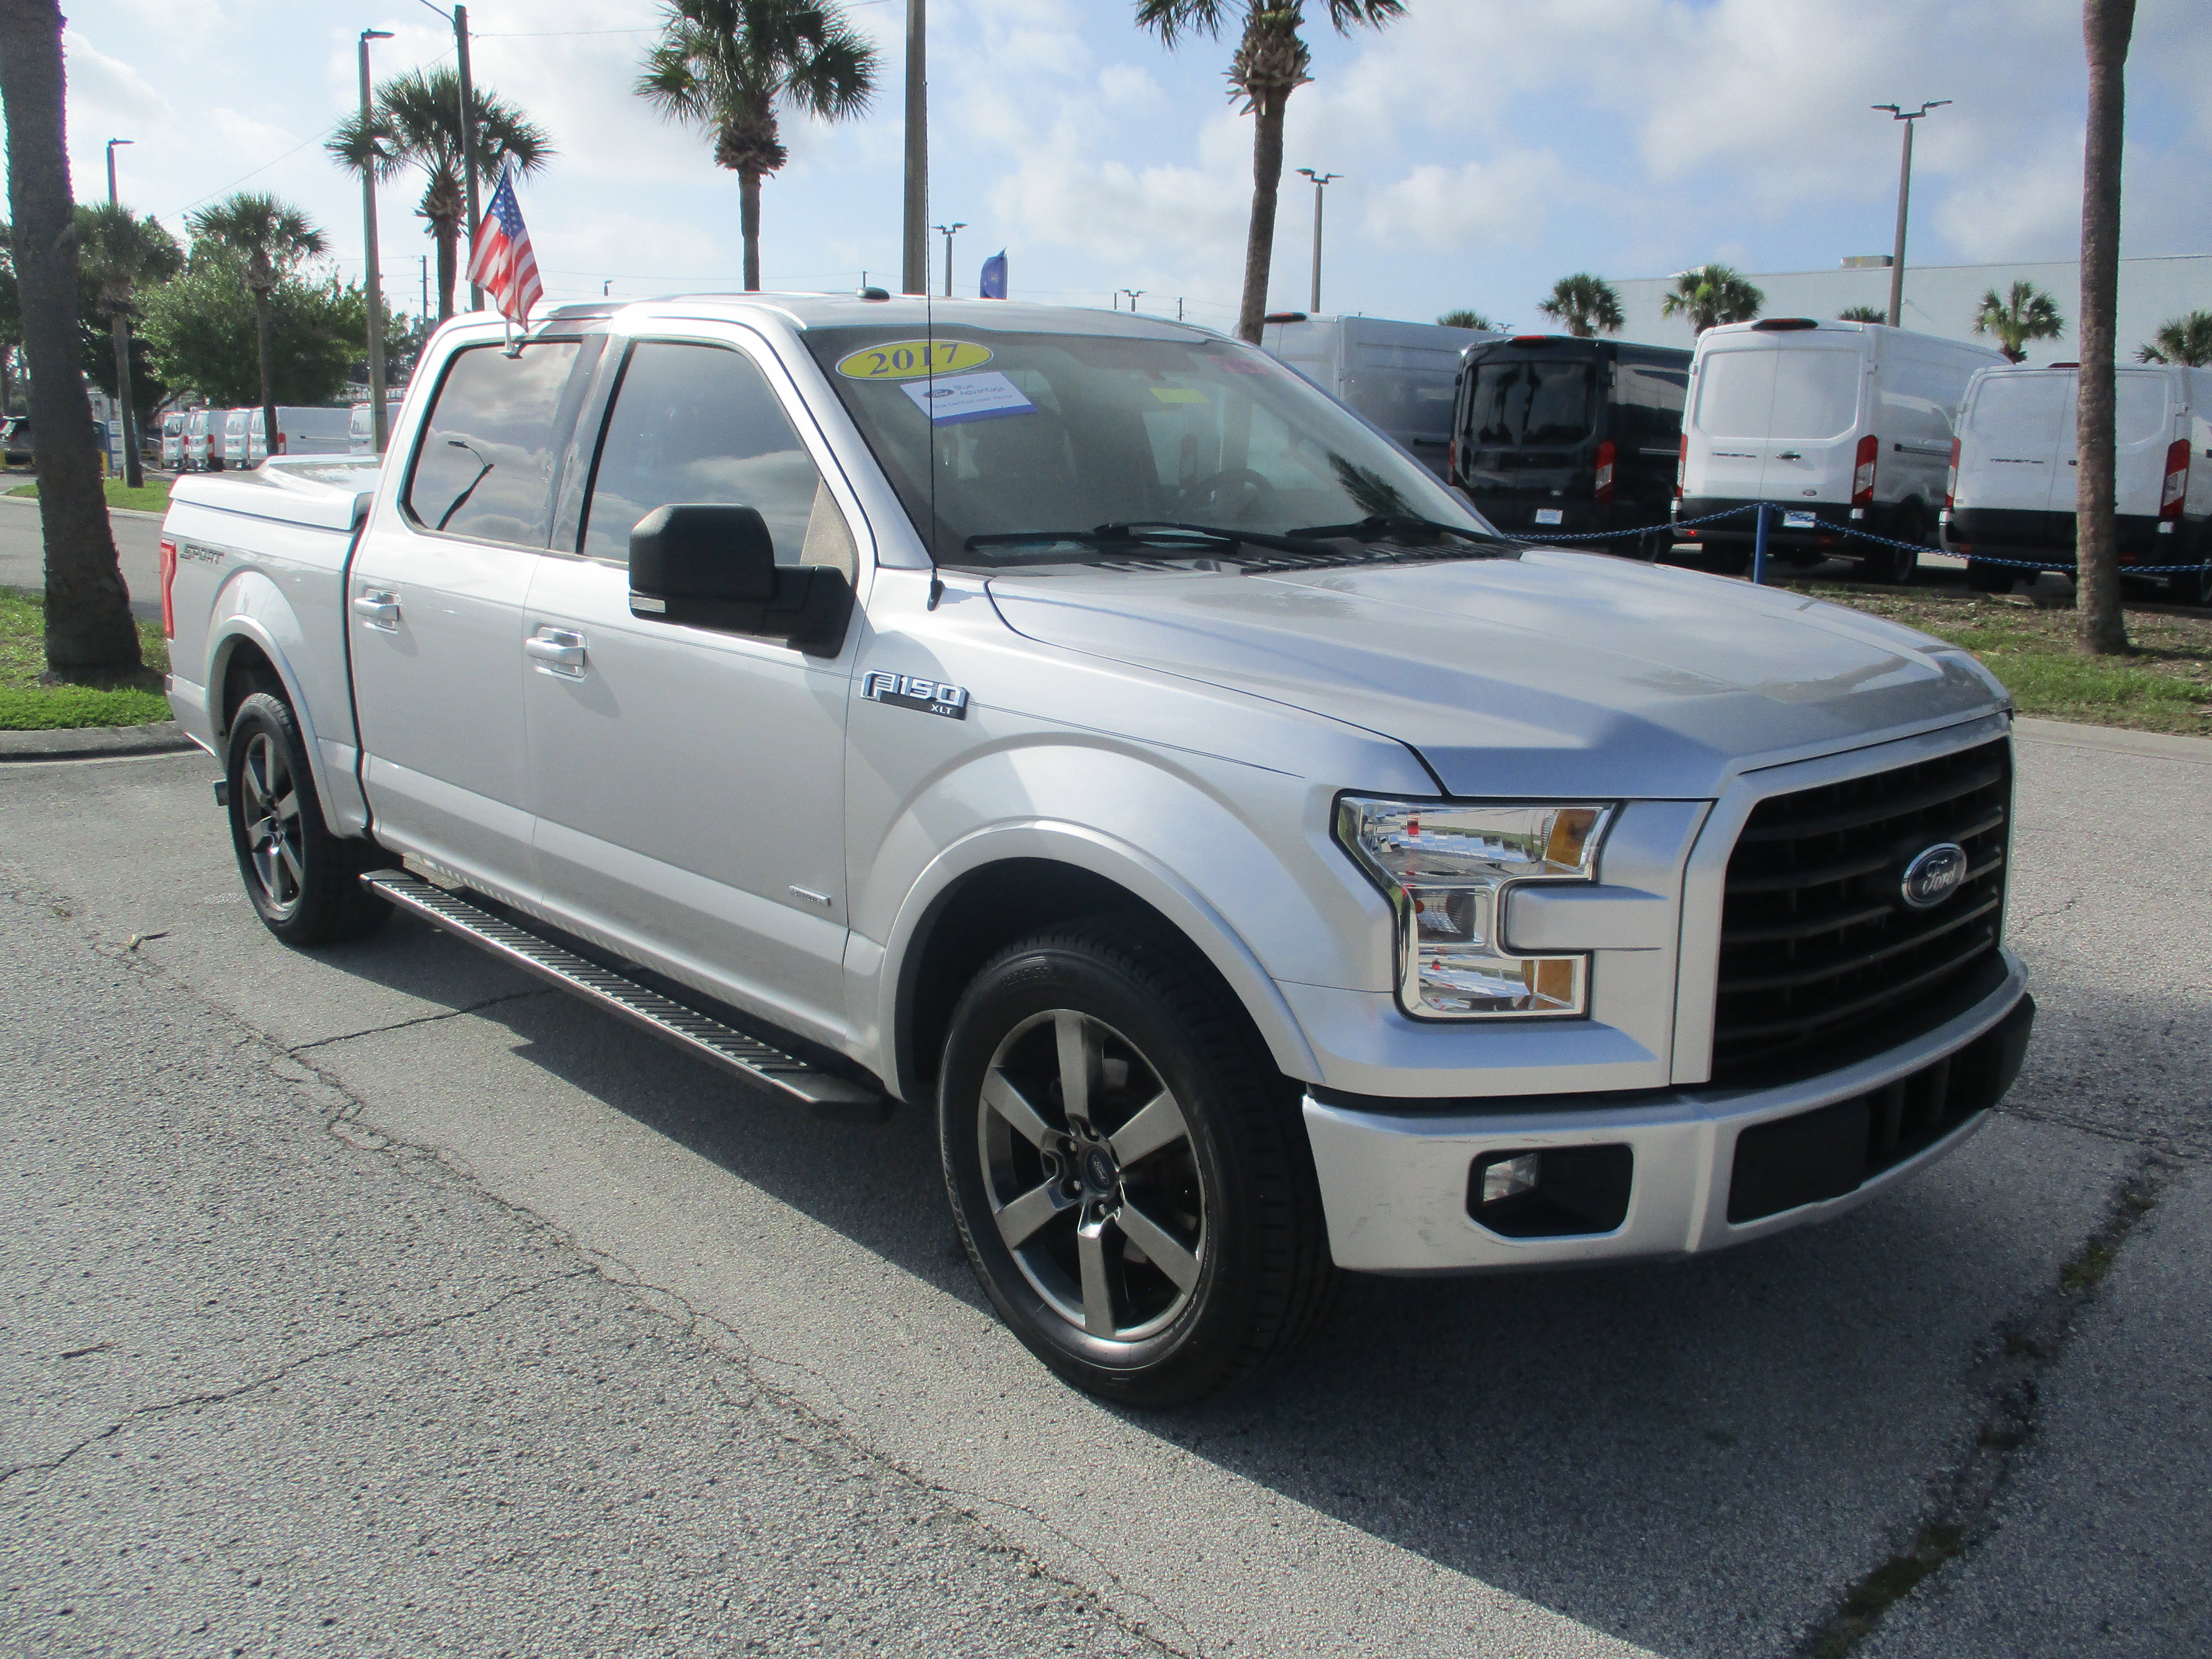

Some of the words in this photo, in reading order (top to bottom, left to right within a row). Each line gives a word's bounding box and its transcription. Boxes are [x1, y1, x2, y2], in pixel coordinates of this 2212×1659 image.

[867, 343, 957, 375] 2017
[960, 386, 1006, 396] Advantage
[179, 543, 225, 564] SPORT
[931, 704, 953, 715] XLT
[1922, 859, 1956, 895] Ford
